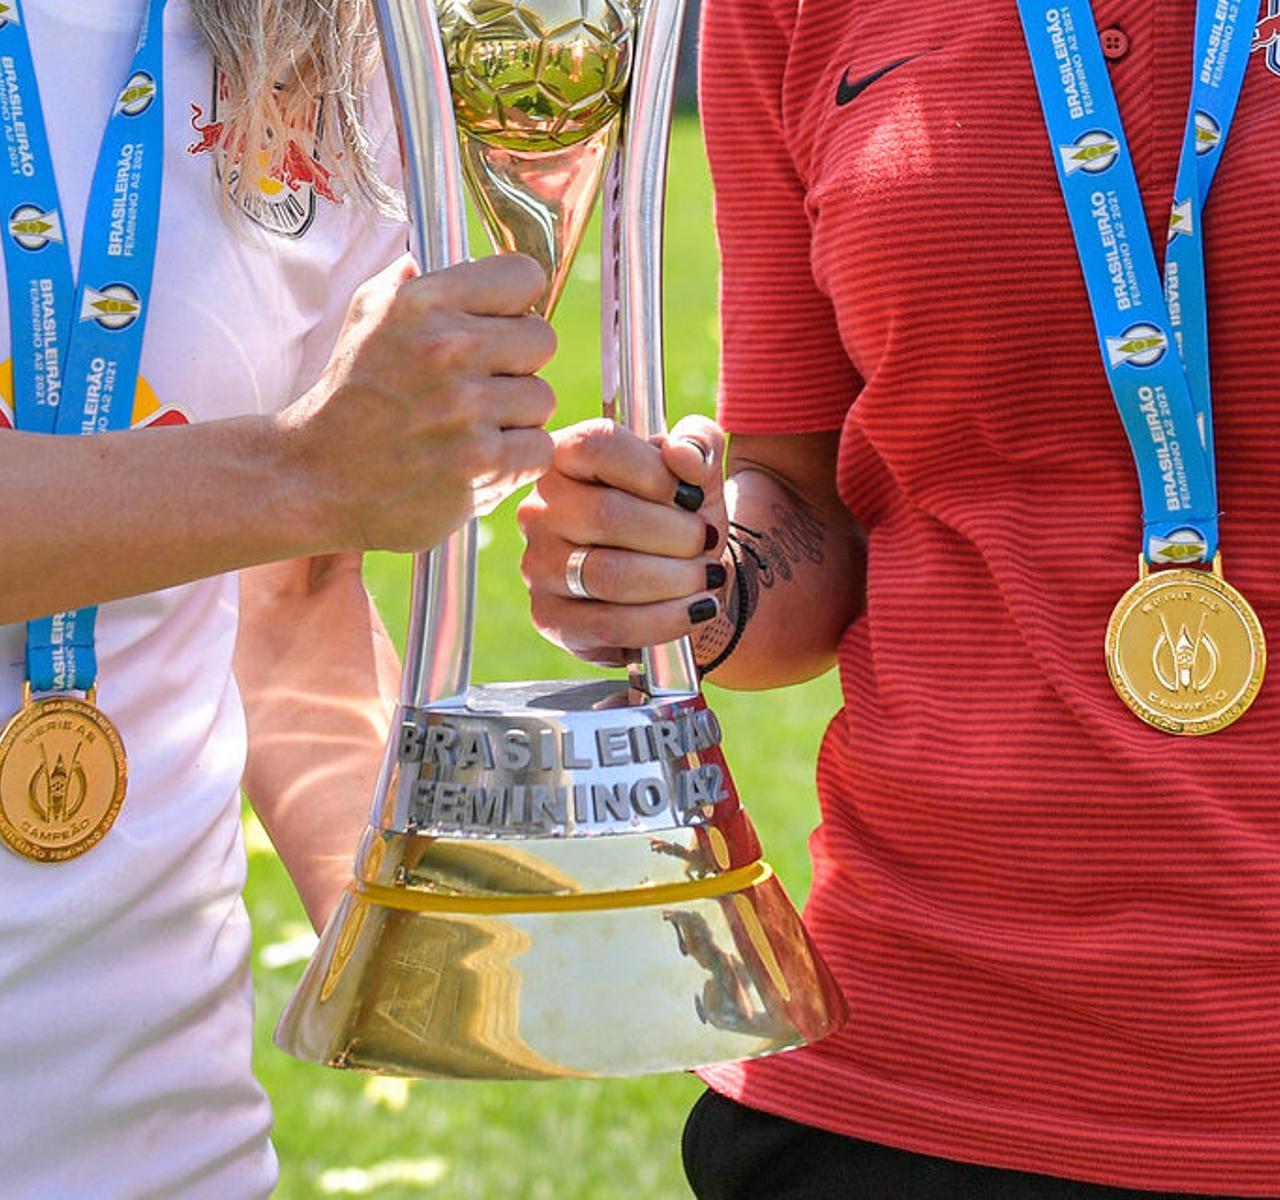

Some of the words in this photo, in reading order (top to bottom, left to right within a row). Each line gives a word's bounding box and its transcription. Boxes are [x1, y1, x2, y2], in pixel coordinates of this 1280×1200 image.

[2, 56, 36, 178] BRASILEIRÃO
[1046, 8, 1084, 120] BRASILEIRÃO
[108, 143, 134, 257] BRASILEIRÃO
[1091, 191, 1131, 311] BRASILEIRÃO
[40, 279, 61, 407] BRASILEIRÃO
[104, 361, 117, 392] 2021
[1138, 386, 1181, 512] BRASILEIRÃO
[408, 776, 670, 828] FEMININO
